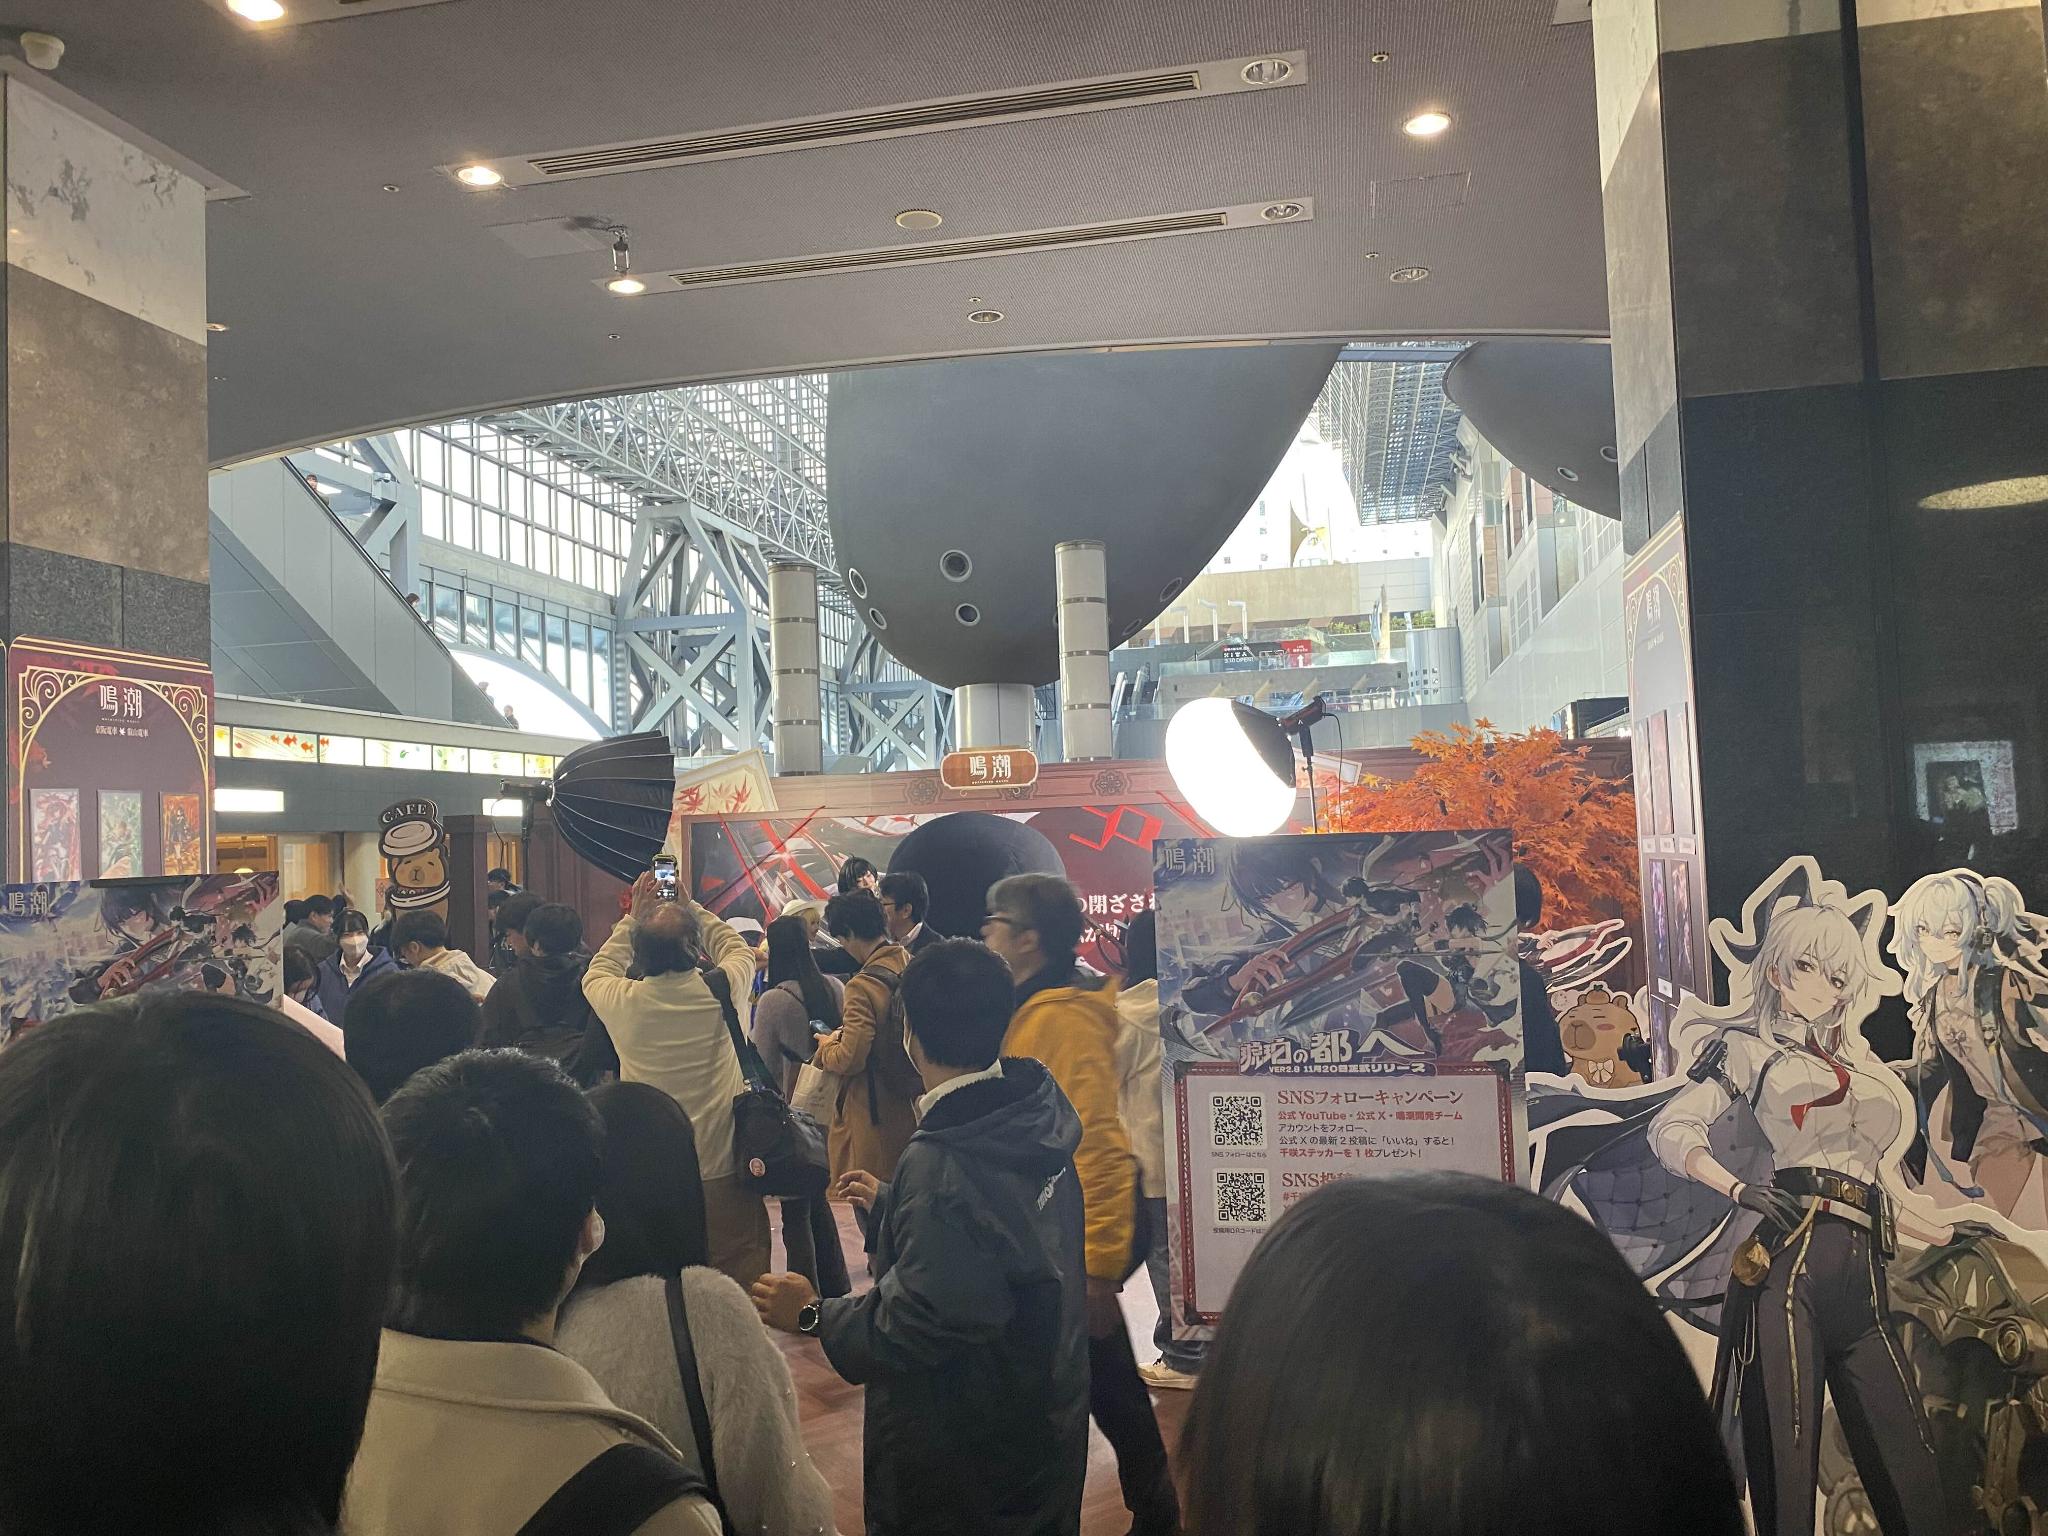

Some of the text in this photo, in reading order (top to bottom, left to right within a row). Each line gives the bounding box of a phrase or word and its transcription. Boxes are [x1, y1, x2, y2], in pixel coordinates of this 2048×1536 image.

[99, 685, 142, 718] 鳴潮
[969, 754, 1011, 779] 鳴潮
[382, 804, 427, 823] CAFE
[1165, 847, 1214, 875] 鳴潮
[1240, 1029, 1425, 1072] 琥珀の都へ
[1278, 1090, 1463, 1105] SNSフォローキャンペーン
[1278, 1123, 1369, 1133] アカウントをフォロー、
